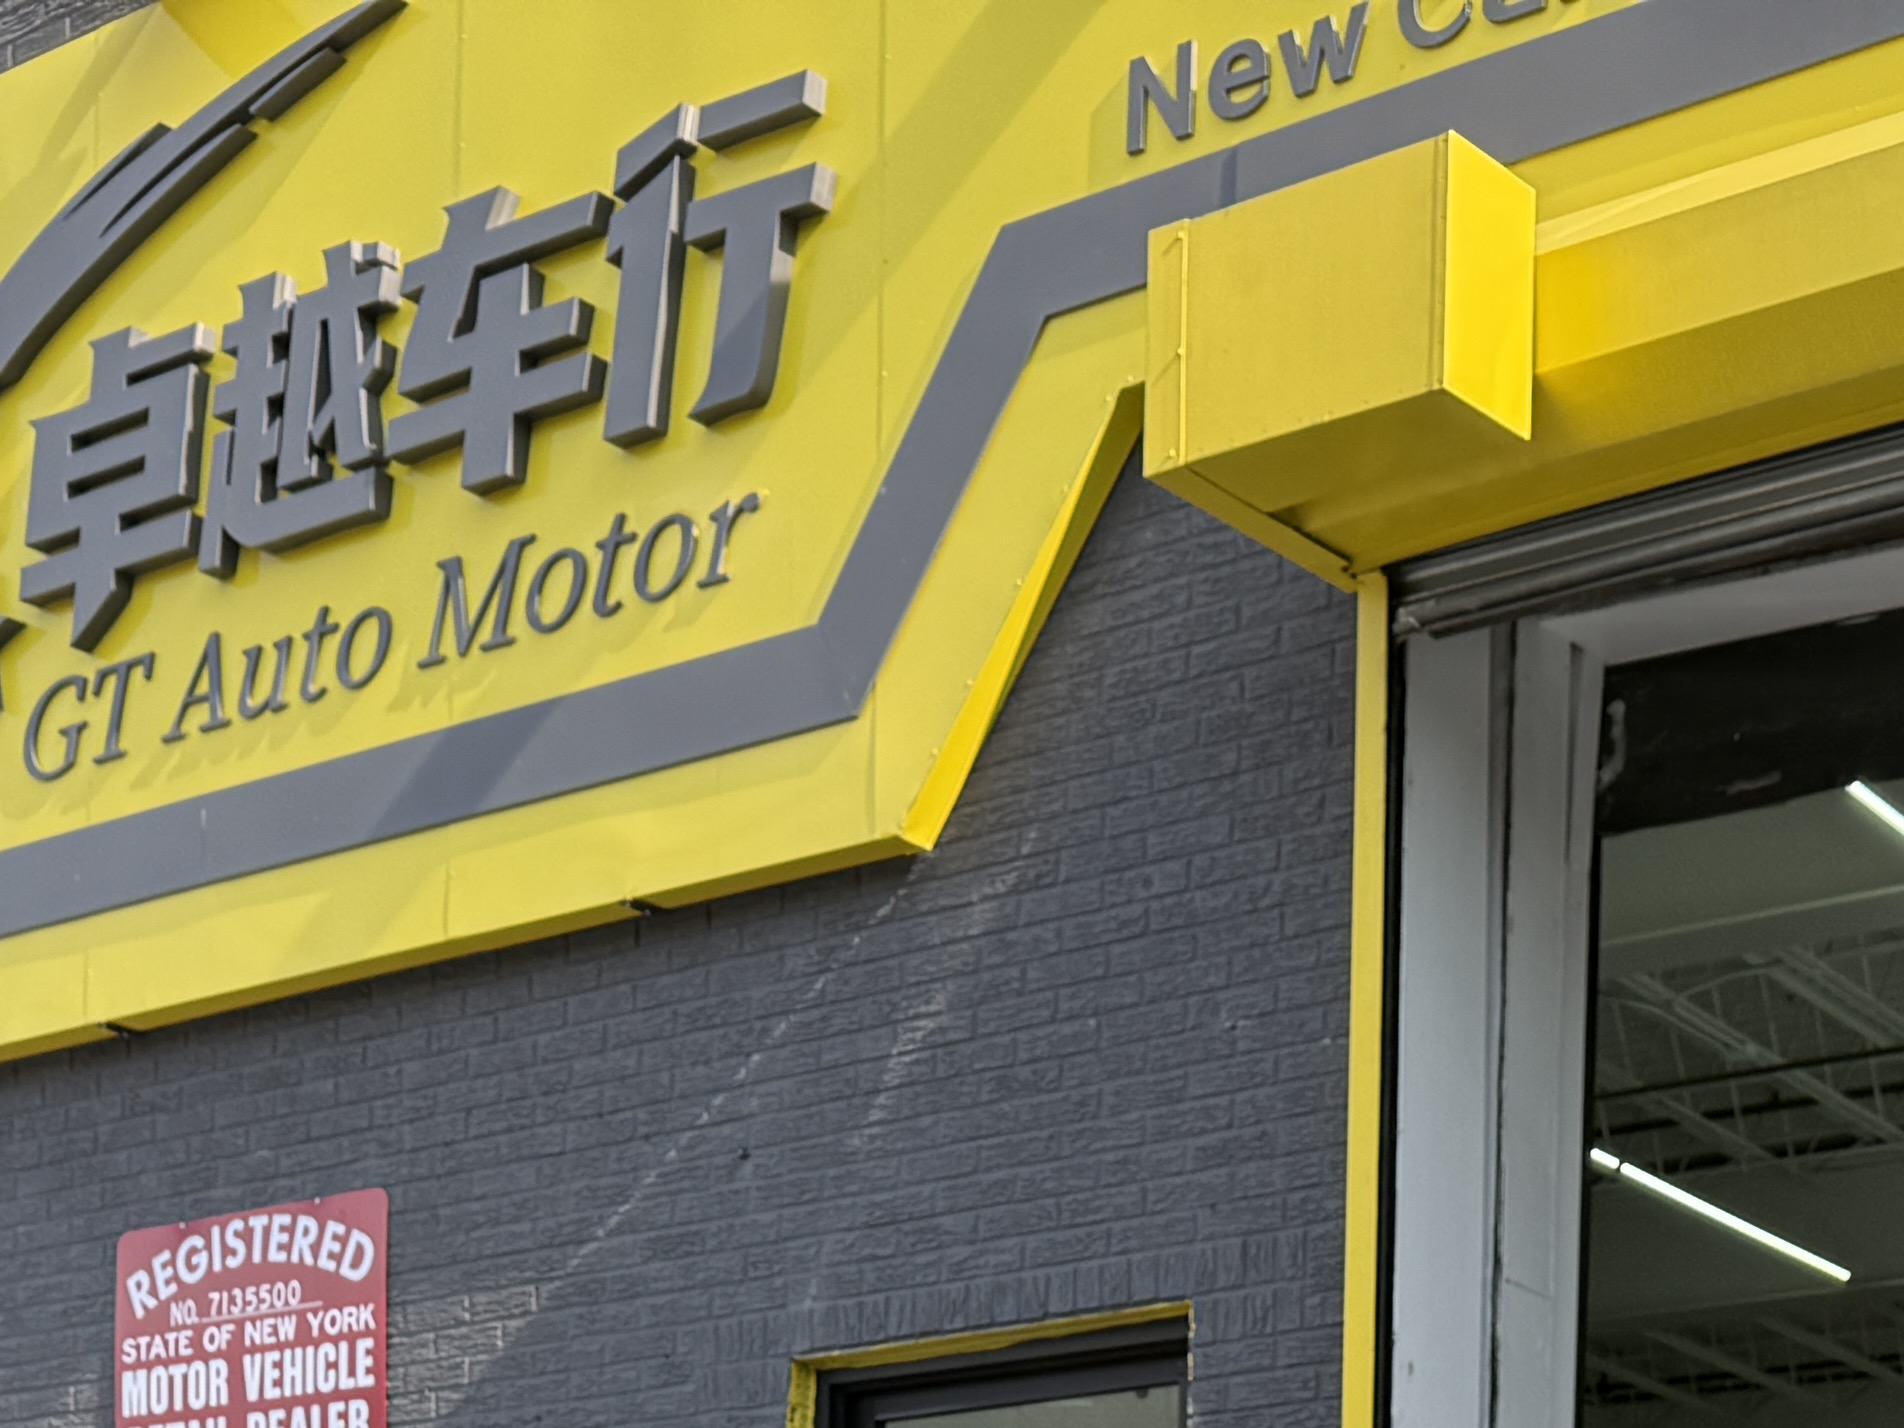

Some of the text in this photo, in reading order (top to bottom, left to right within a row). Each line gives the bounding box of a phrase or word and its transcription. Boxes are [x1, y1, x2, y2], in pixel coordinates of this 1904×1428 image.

[1126, 1, 1371, 155] New
[19, 69, 836, 652] 卓越车行
[22, 490, 759, 783] GT Auto Motor
[126, 1213, 375, 1319] REGISTERED
[208, 1280, 302, 1317] 7135500
[121, 1337, 376, 1418] MOTOR VEHICLE
[122, 1303, 376, 1364] STATE OF NEW YORK
